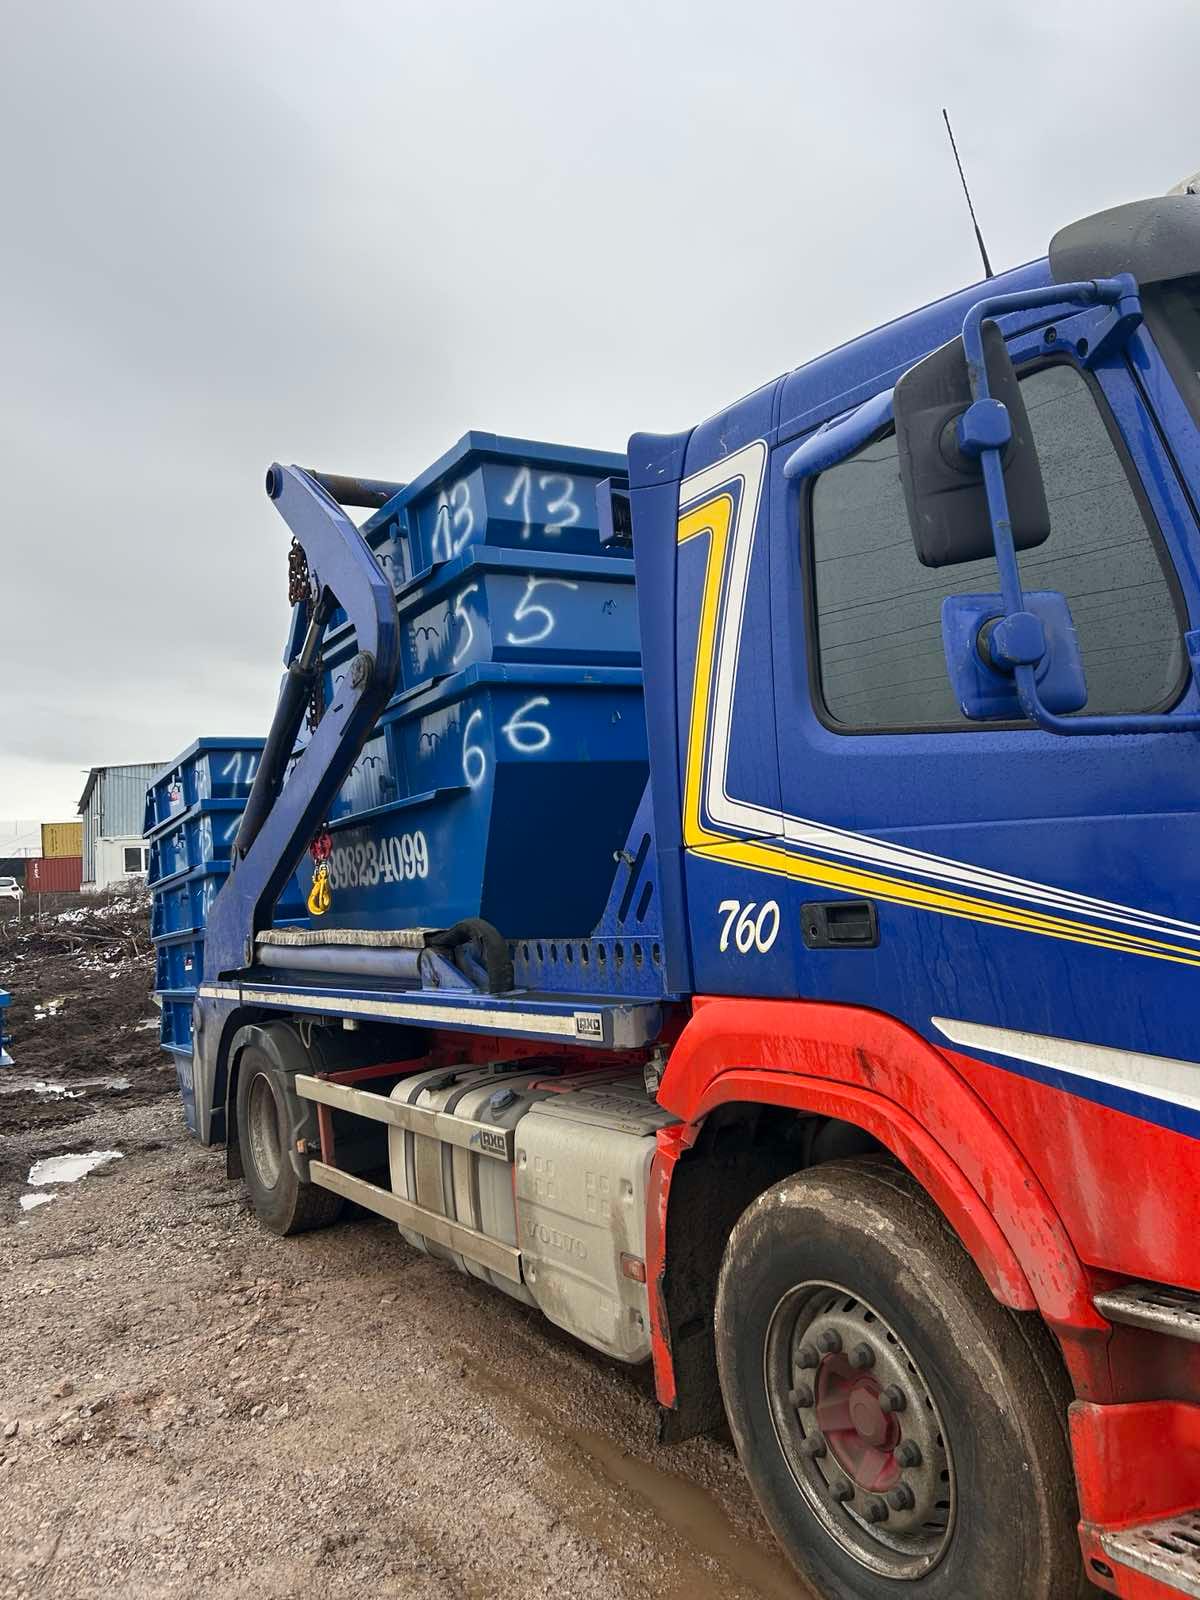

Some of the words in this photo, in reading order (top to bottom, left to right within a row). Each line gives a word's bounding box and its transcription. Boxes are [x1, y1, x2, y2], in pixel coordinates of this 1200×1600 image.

[432, 480, 474, 560] 13
[505, 467, 580, 538] 13
[452, 584, 479, 665] 5
[506, 576, 579, 645] 5
[462, 709, 486, 787] 6
[502, 697, 551, 752] 6
[717, 900, 780, 953] 760
